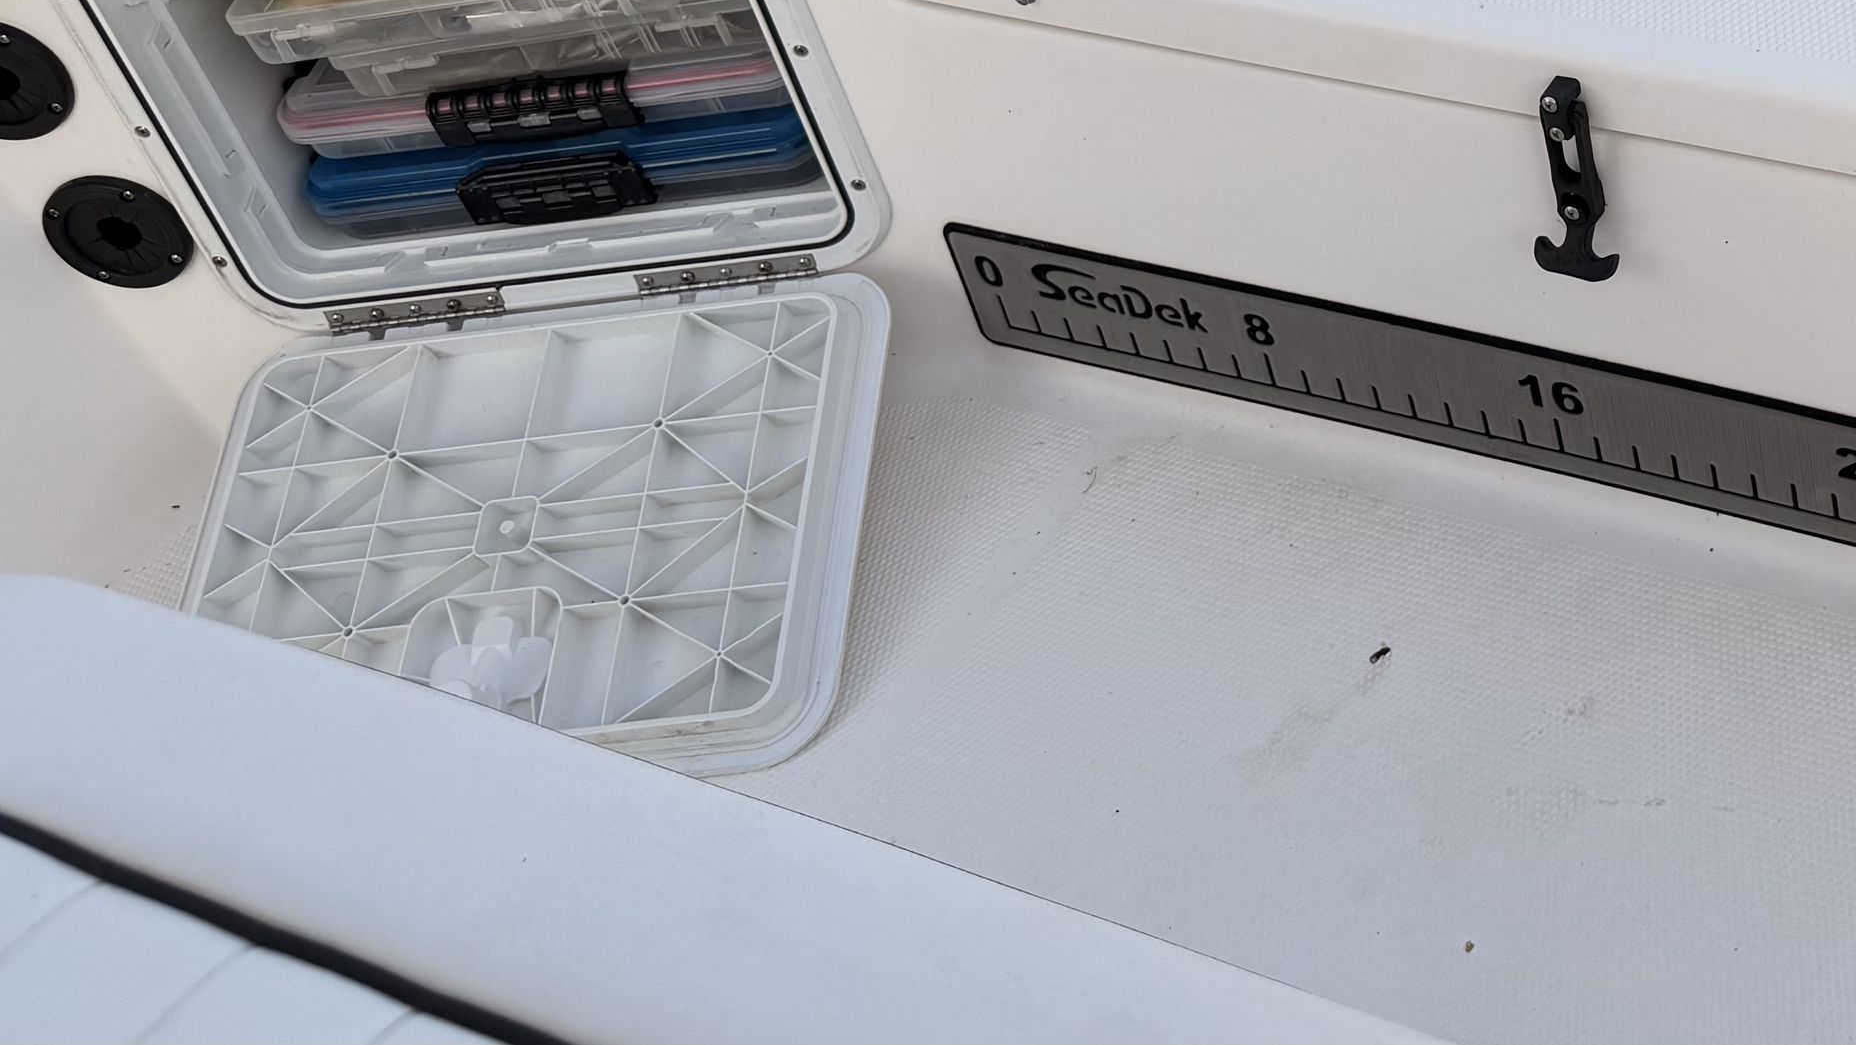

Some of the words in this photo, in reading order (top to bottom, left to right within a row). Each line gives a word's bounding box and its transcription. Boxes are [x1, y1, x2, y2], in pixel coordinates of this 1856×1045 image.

[973, 255, 1004, 288] 0
[1030, 263, 1209, 334] SeaDek
[1242, 313, 1276, 347] 8
[1517, 374, 1585, 416] 16
